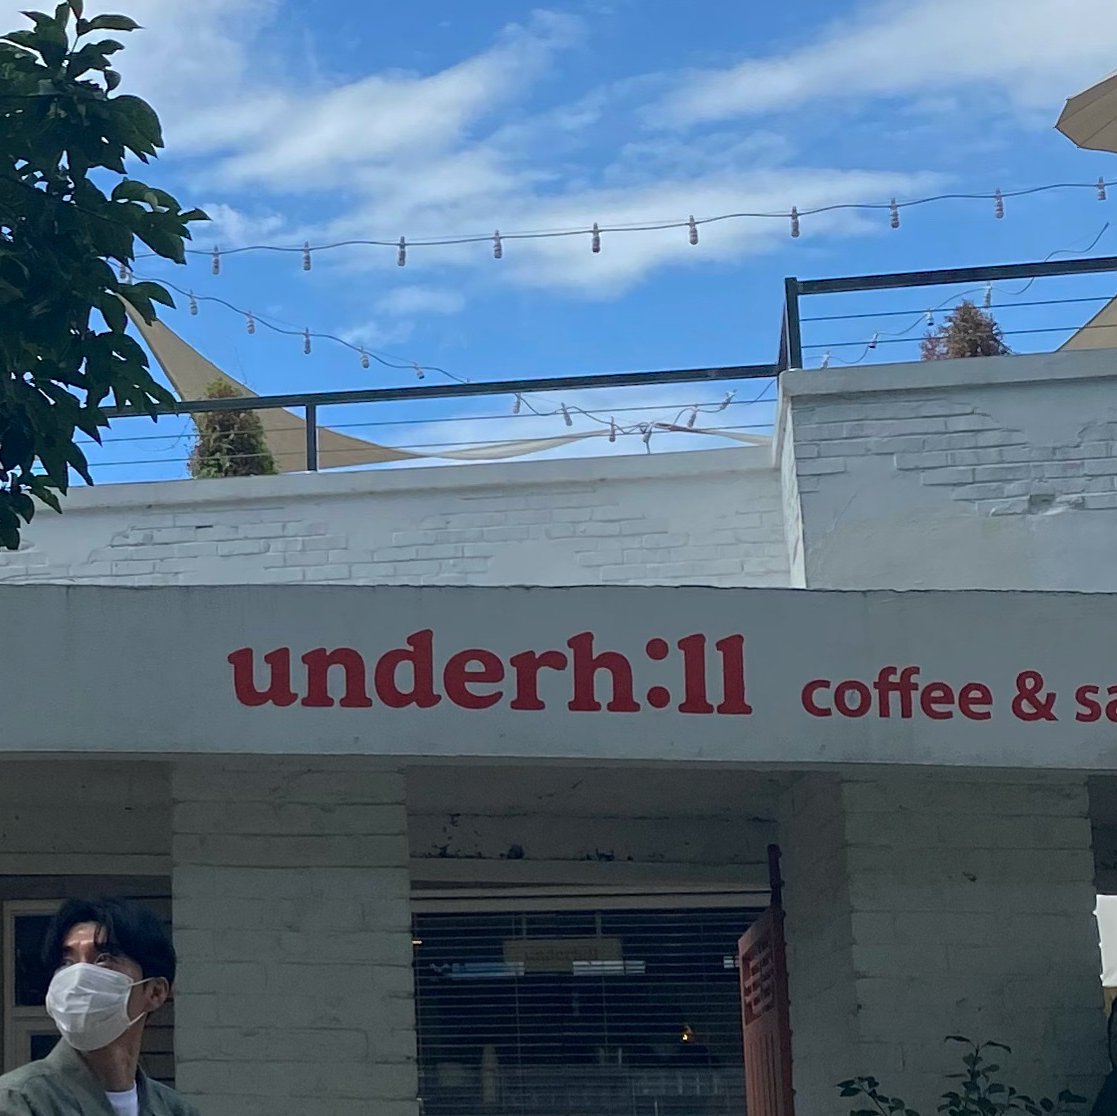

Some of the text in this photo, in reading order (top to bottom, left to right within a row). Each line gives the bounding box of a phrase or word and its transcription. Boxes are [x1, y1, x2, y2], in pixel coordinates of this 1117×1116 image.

[228, 629, 752, 714] underh:ll
[801, 665, 993, 720] coffee
[1011, 670, 1059, 722] &
